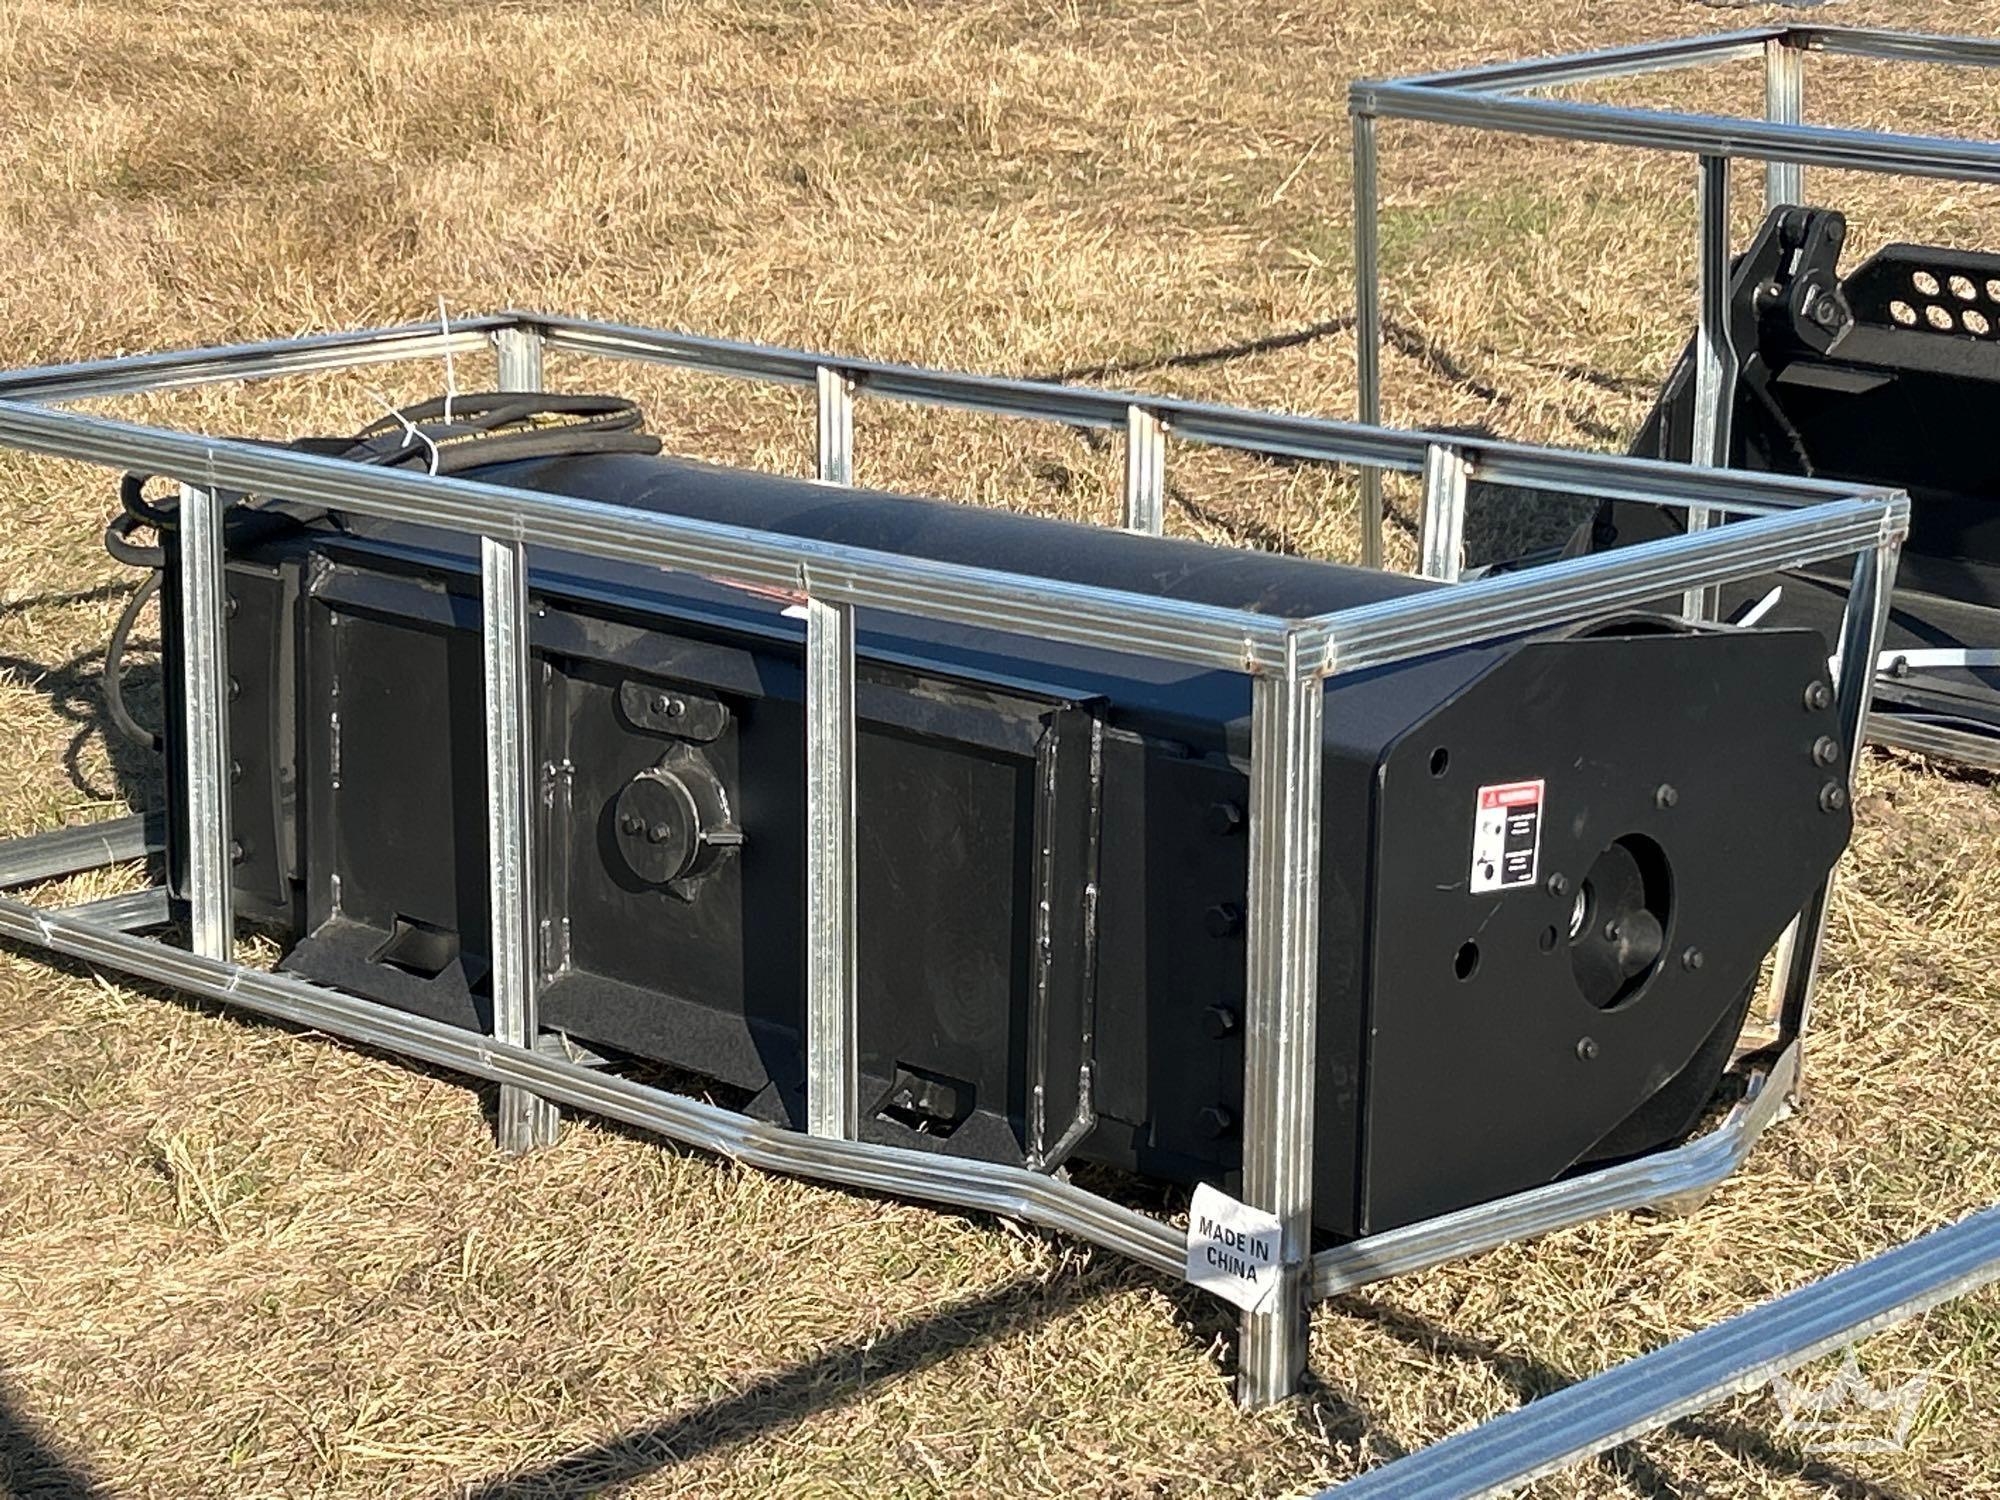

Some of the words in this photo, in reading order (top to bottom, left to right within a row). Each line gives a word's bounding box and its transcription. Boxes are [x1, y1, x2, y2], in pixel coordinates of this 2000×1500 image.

[1199, 1216, 1245, 1252] MADE
[1251, 1237, 1269, 1261] IN
[1207, 1246, 1257, 1284] CHINA
